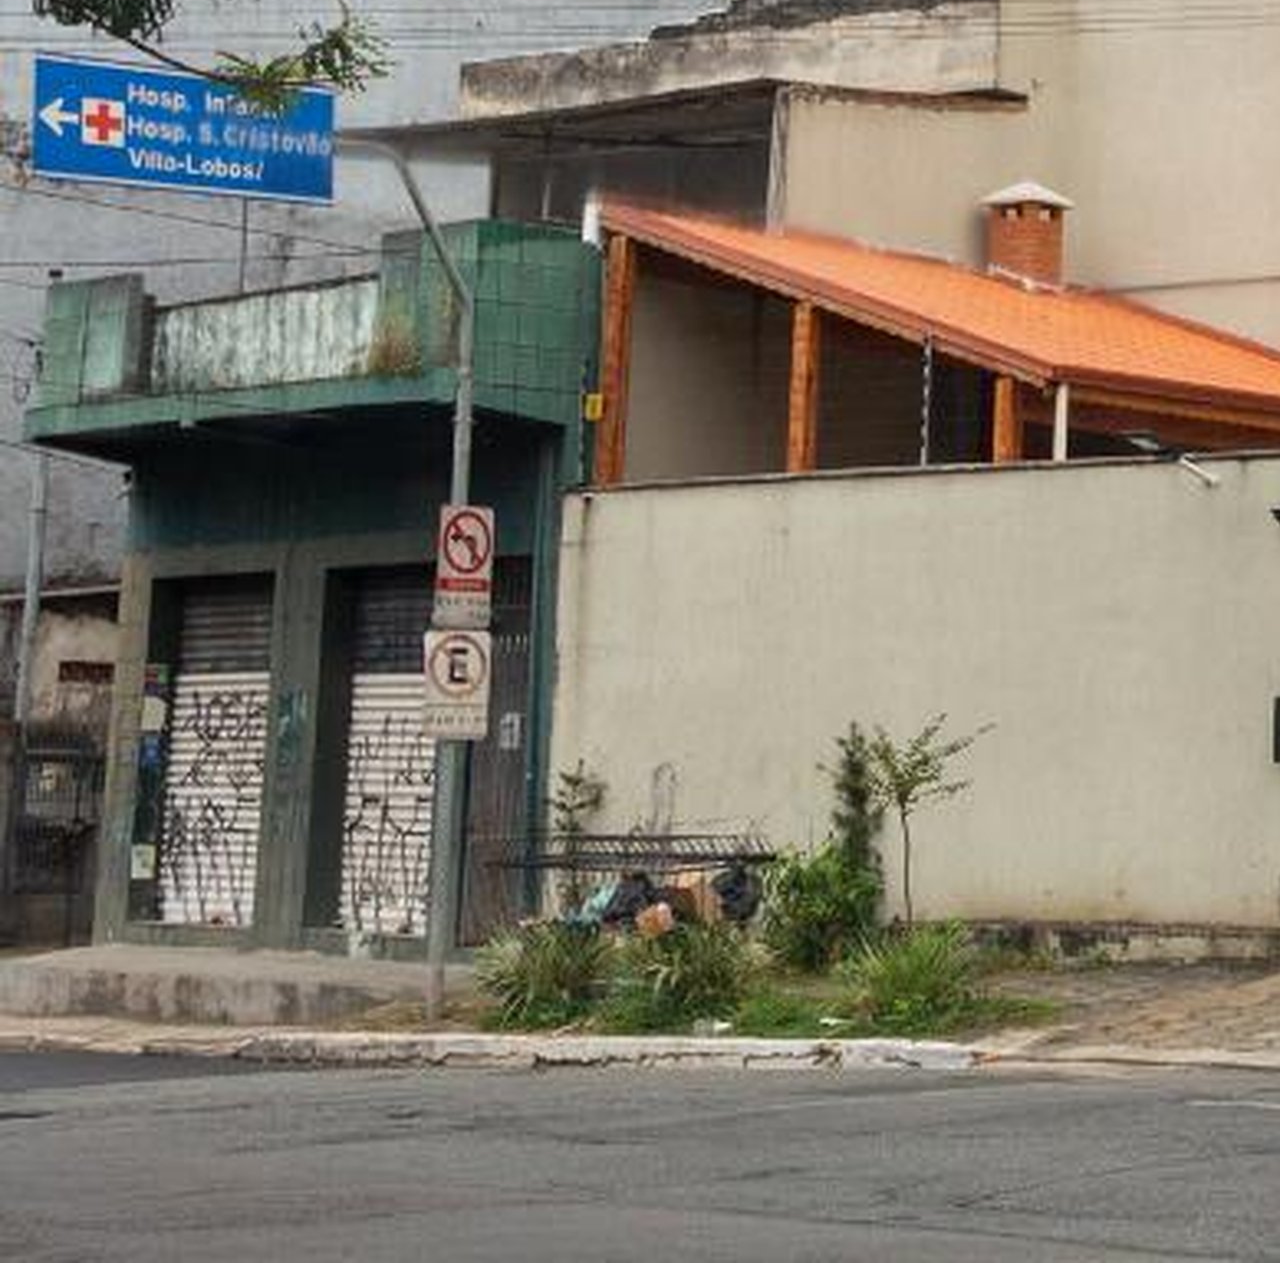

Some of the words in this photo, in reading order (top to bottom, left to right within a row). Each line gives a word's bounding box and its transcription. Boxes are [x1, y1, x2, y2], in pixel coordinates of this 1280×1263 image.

[126, 82, 193, 113] Hosp.
[126, 115, 193, 145] Hosp.
[448, 647, 469, 684] E
